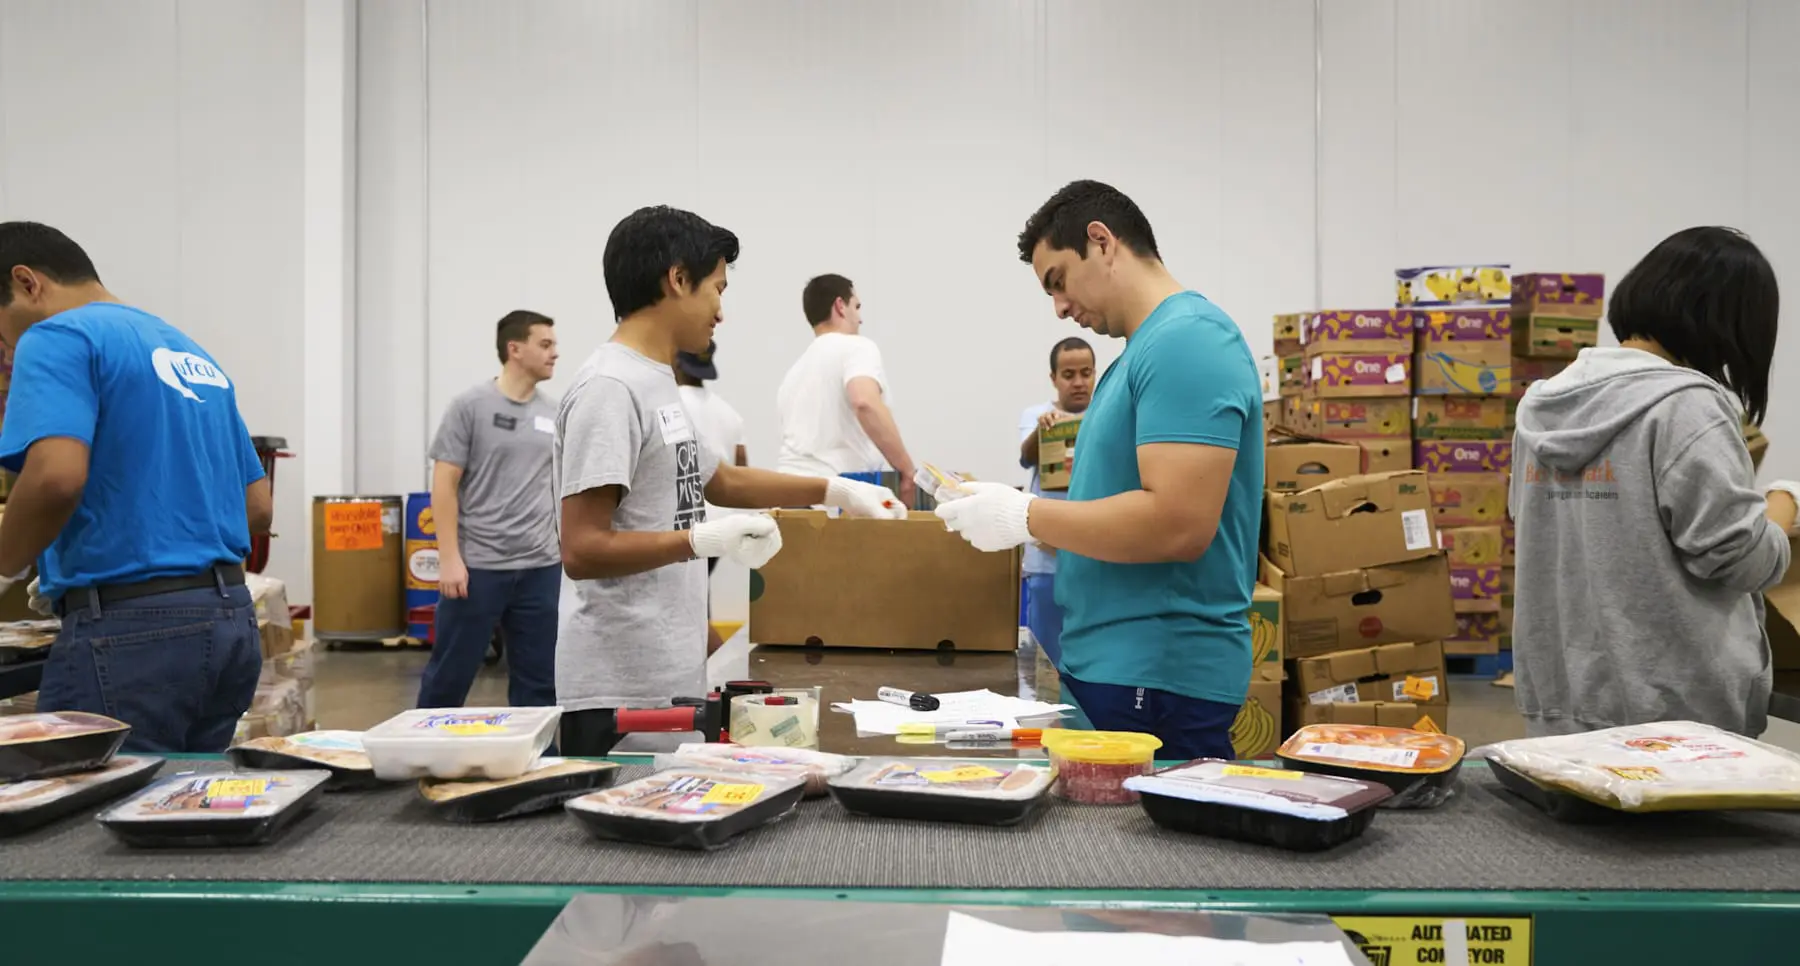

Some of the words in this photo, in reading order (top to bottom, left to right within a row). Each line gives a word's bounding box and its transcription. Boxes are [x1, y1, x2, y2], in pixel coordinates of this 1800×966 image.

[1355, 314, 1382, 328] One
[1456, 315, 1483, 329] One
[175, 357, 216, 379] ufcu
[1354, 360, 1381, 374] One
[1454, 447, 1480, 461] One
[1411, 924, 1512, 942] AUTATED
